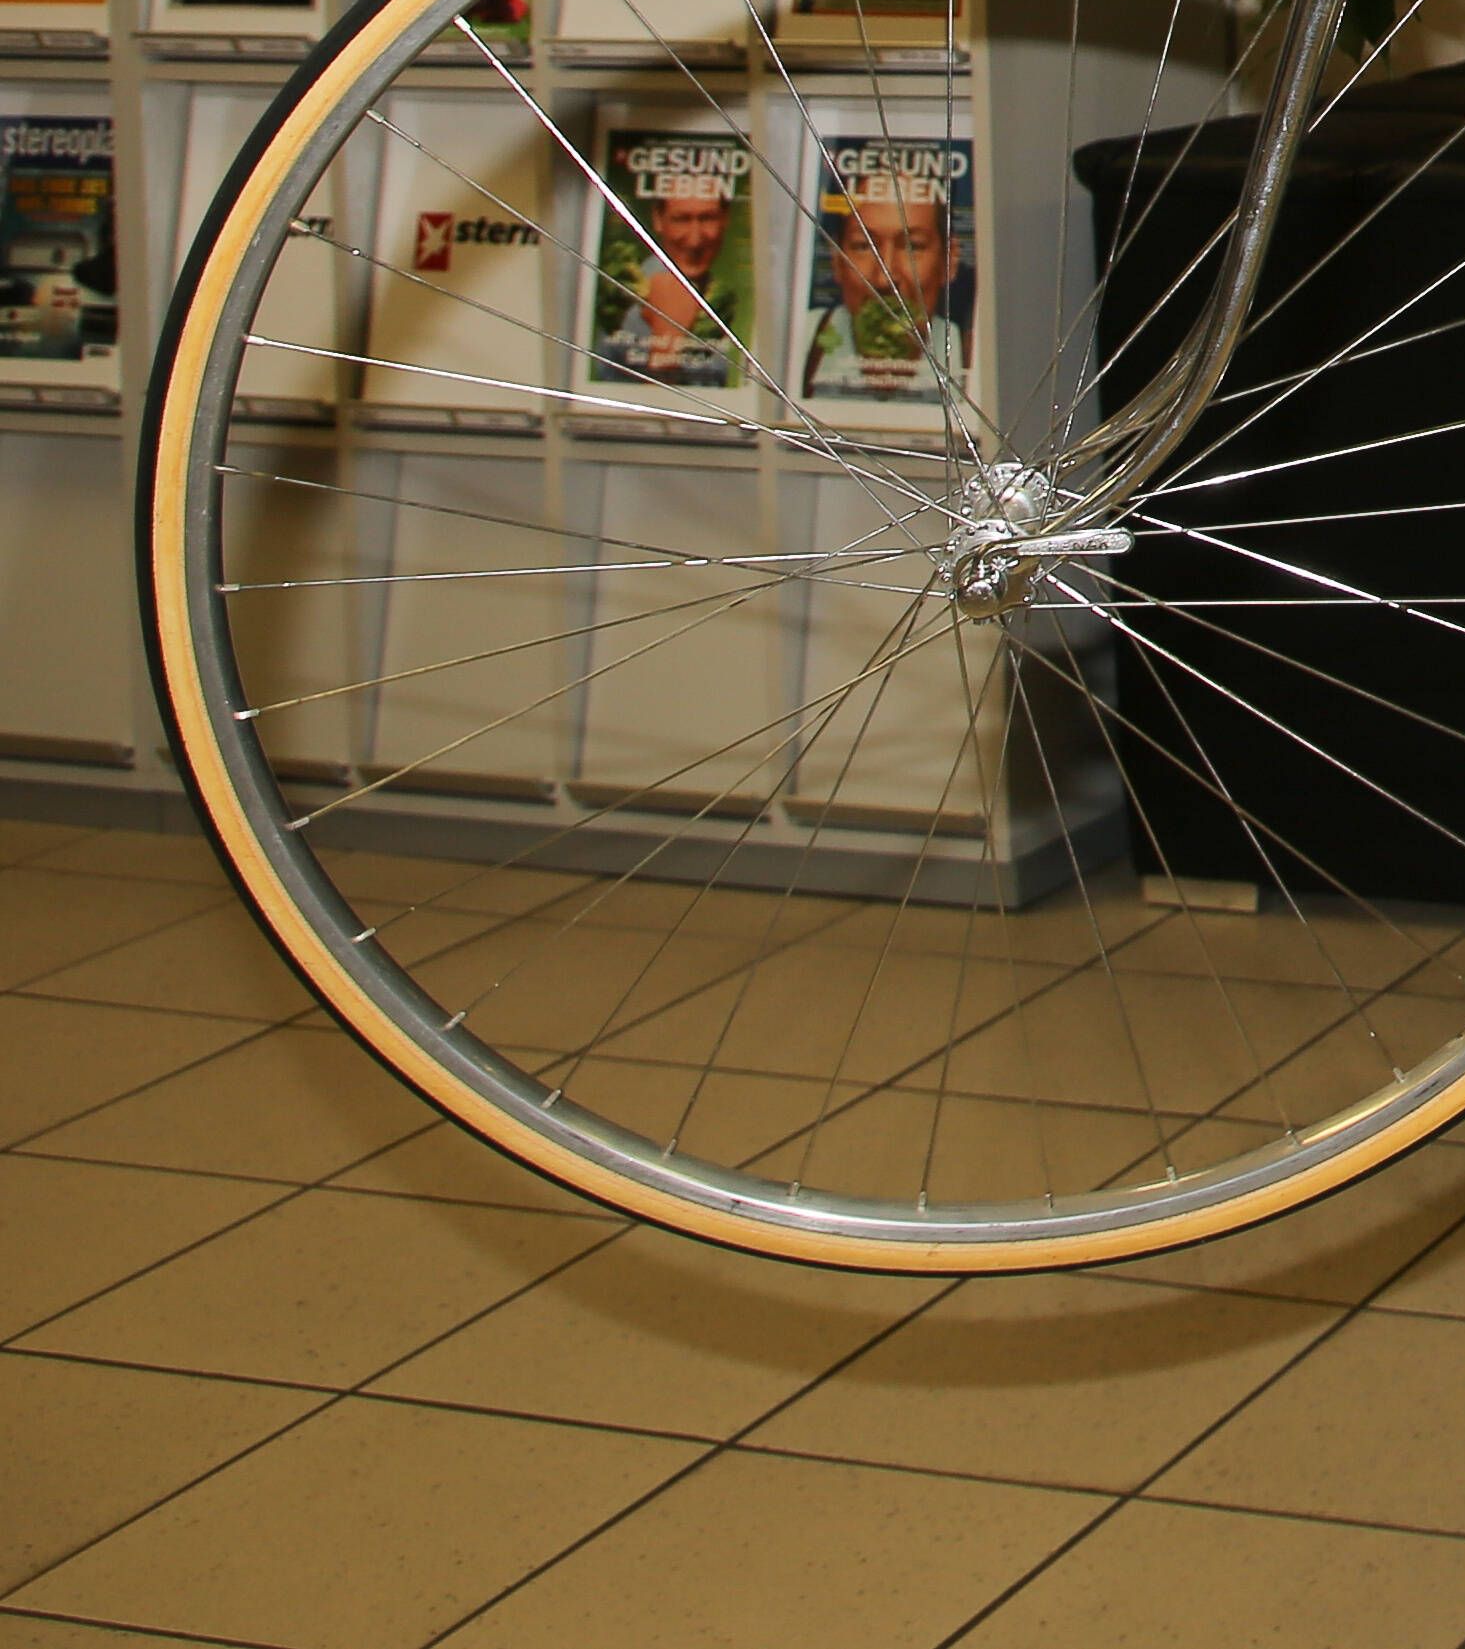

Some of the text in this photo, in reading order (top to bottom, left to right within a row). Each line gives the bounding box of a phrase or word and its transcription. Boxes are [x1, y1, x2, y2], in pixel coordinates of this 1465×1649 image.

[627, 146, 750, 176] GESUND
[837, 148, 969, 179] GESUND
[637, 172, 736, 201] LEBEN
[847, 175, 950, 204] LEBEN
[455, 216, 540, 245] stern
